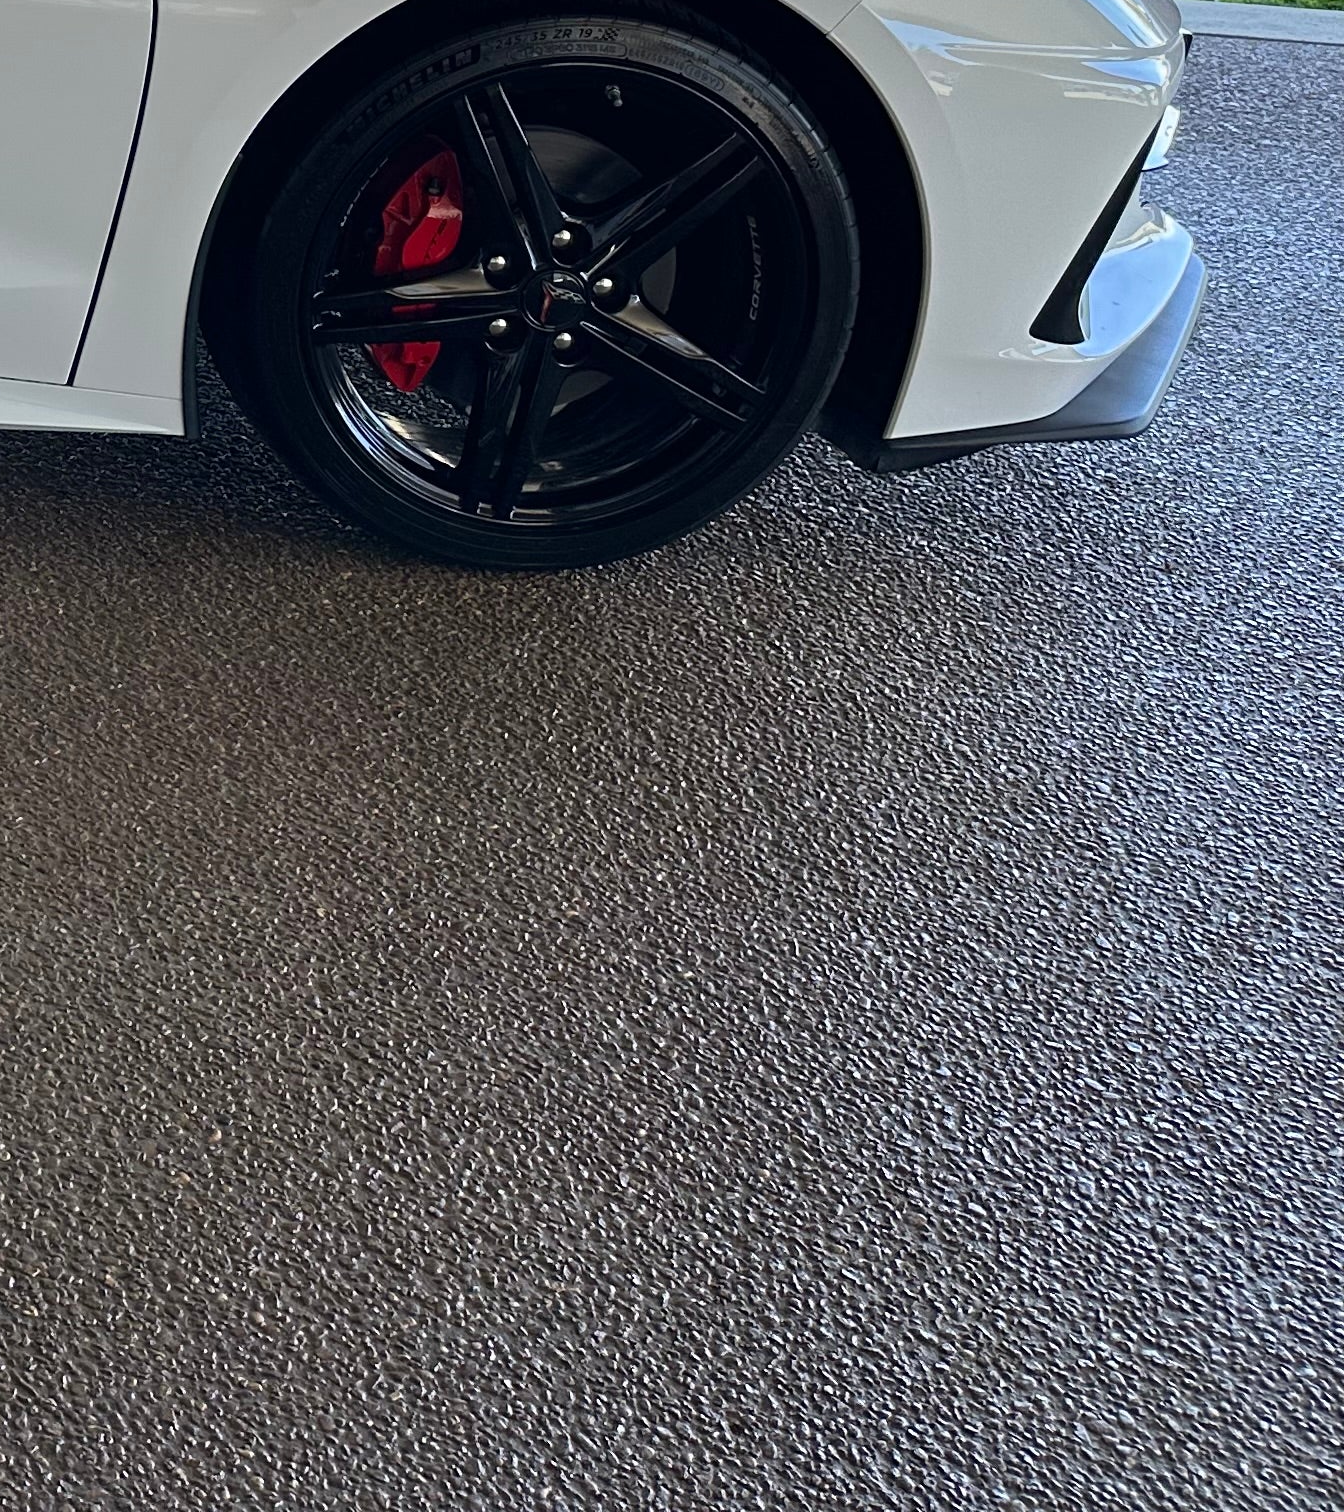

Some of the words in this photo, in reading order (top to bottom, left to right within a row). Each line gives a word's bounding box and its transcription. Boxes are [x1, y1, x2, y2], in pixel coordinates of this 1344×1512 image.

[553, 28, 572, 40] ZR
[579, 28, 593, 39] 19
[748, 215, 762, 321] CORVETTE
